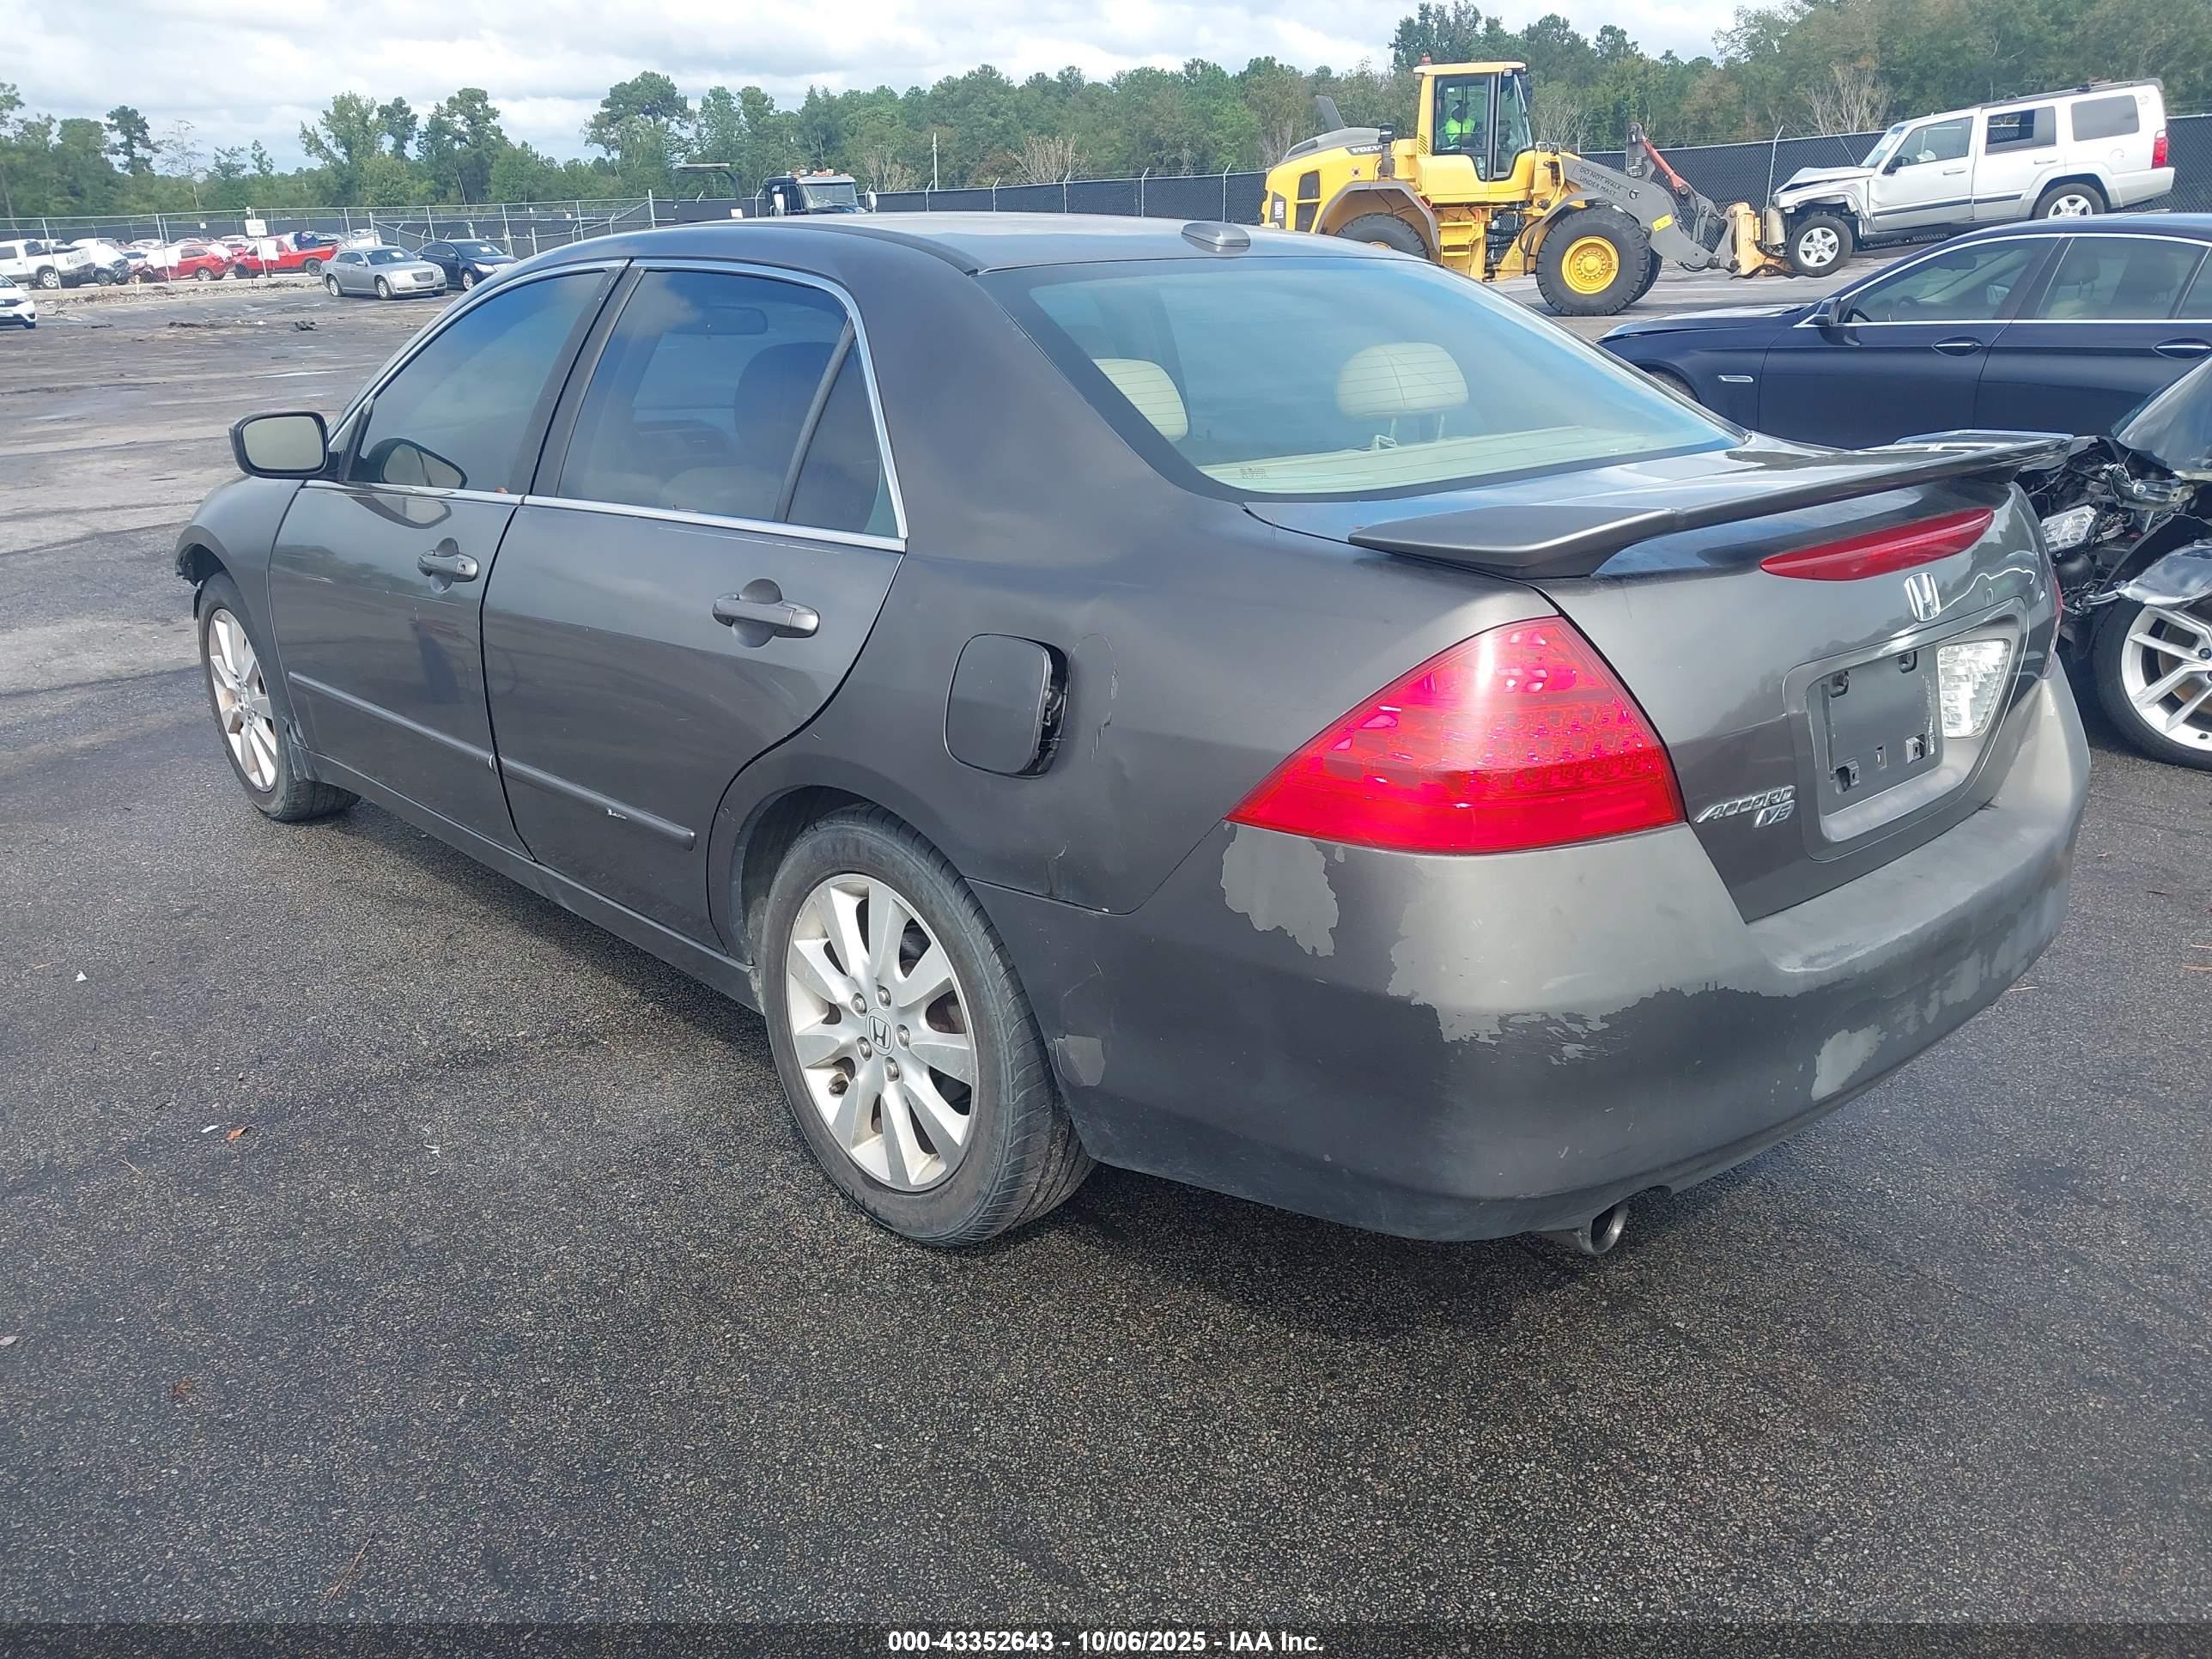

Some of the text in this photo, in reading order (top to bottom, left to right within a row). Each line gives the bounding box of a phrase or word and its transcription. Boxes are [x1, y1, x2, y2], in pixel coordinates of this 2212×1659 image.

[1579, 175, 1617, 197] UNDER MAST
[1589, 172, 1604, 182] NOT
[1604, 178, 1622, 191] WALK
[1693, 785, 1796, 823] ACCORD
[1753, 799, 1796, 829] V6
